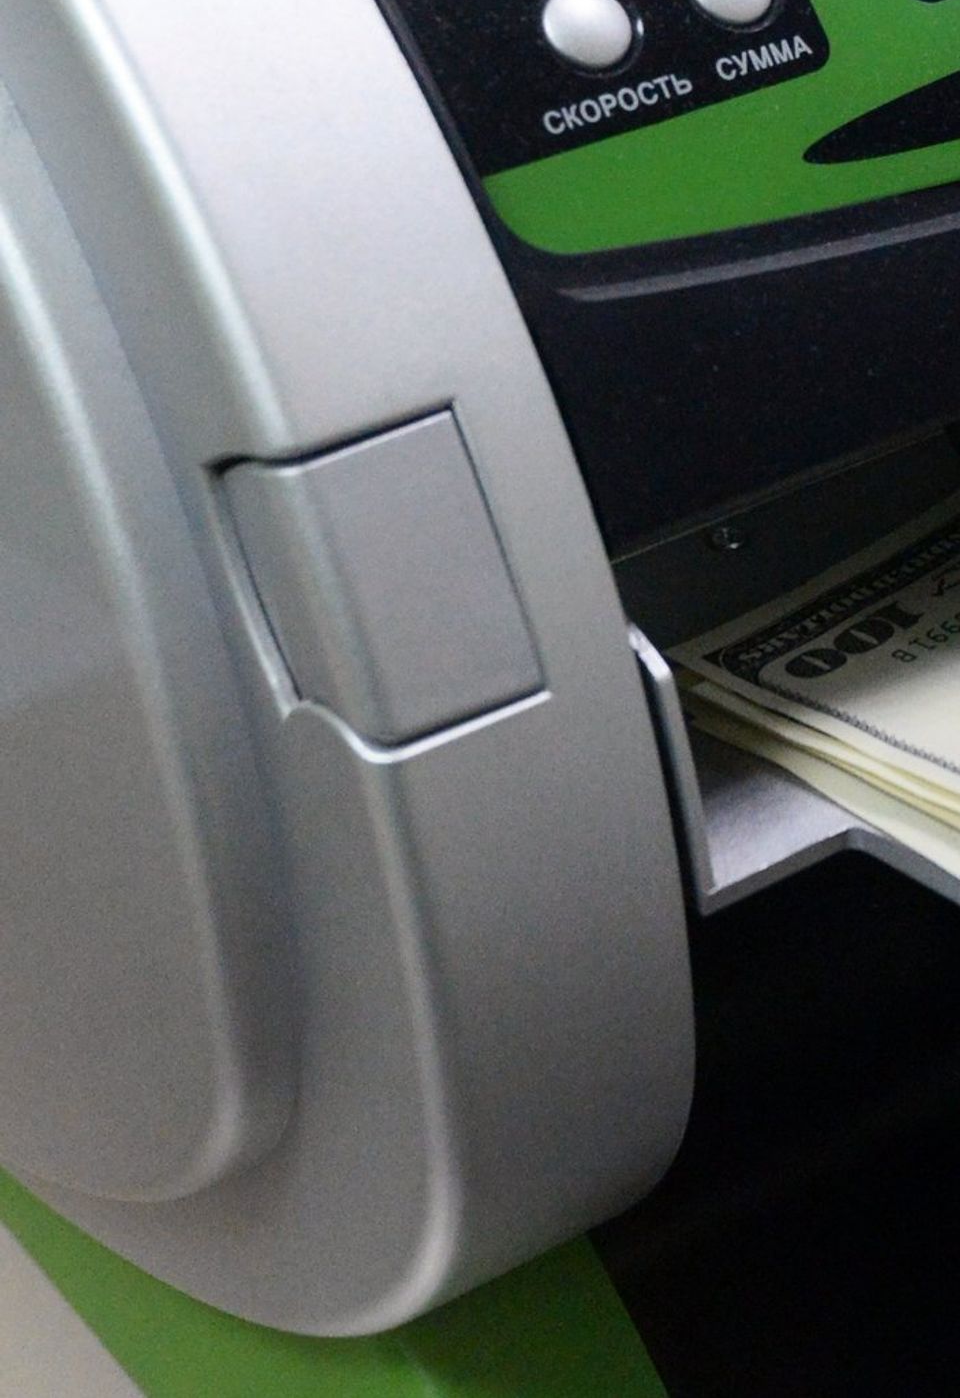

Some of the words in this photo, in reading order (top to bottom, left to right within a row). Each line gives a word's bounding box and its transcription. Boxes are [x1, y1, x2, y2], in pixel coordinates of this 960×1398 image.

[715, 34, 813, 81] СУММА
[542, 72, 693, 135] СКОРОСТЬ
[784, 602, 924, 679] 100
